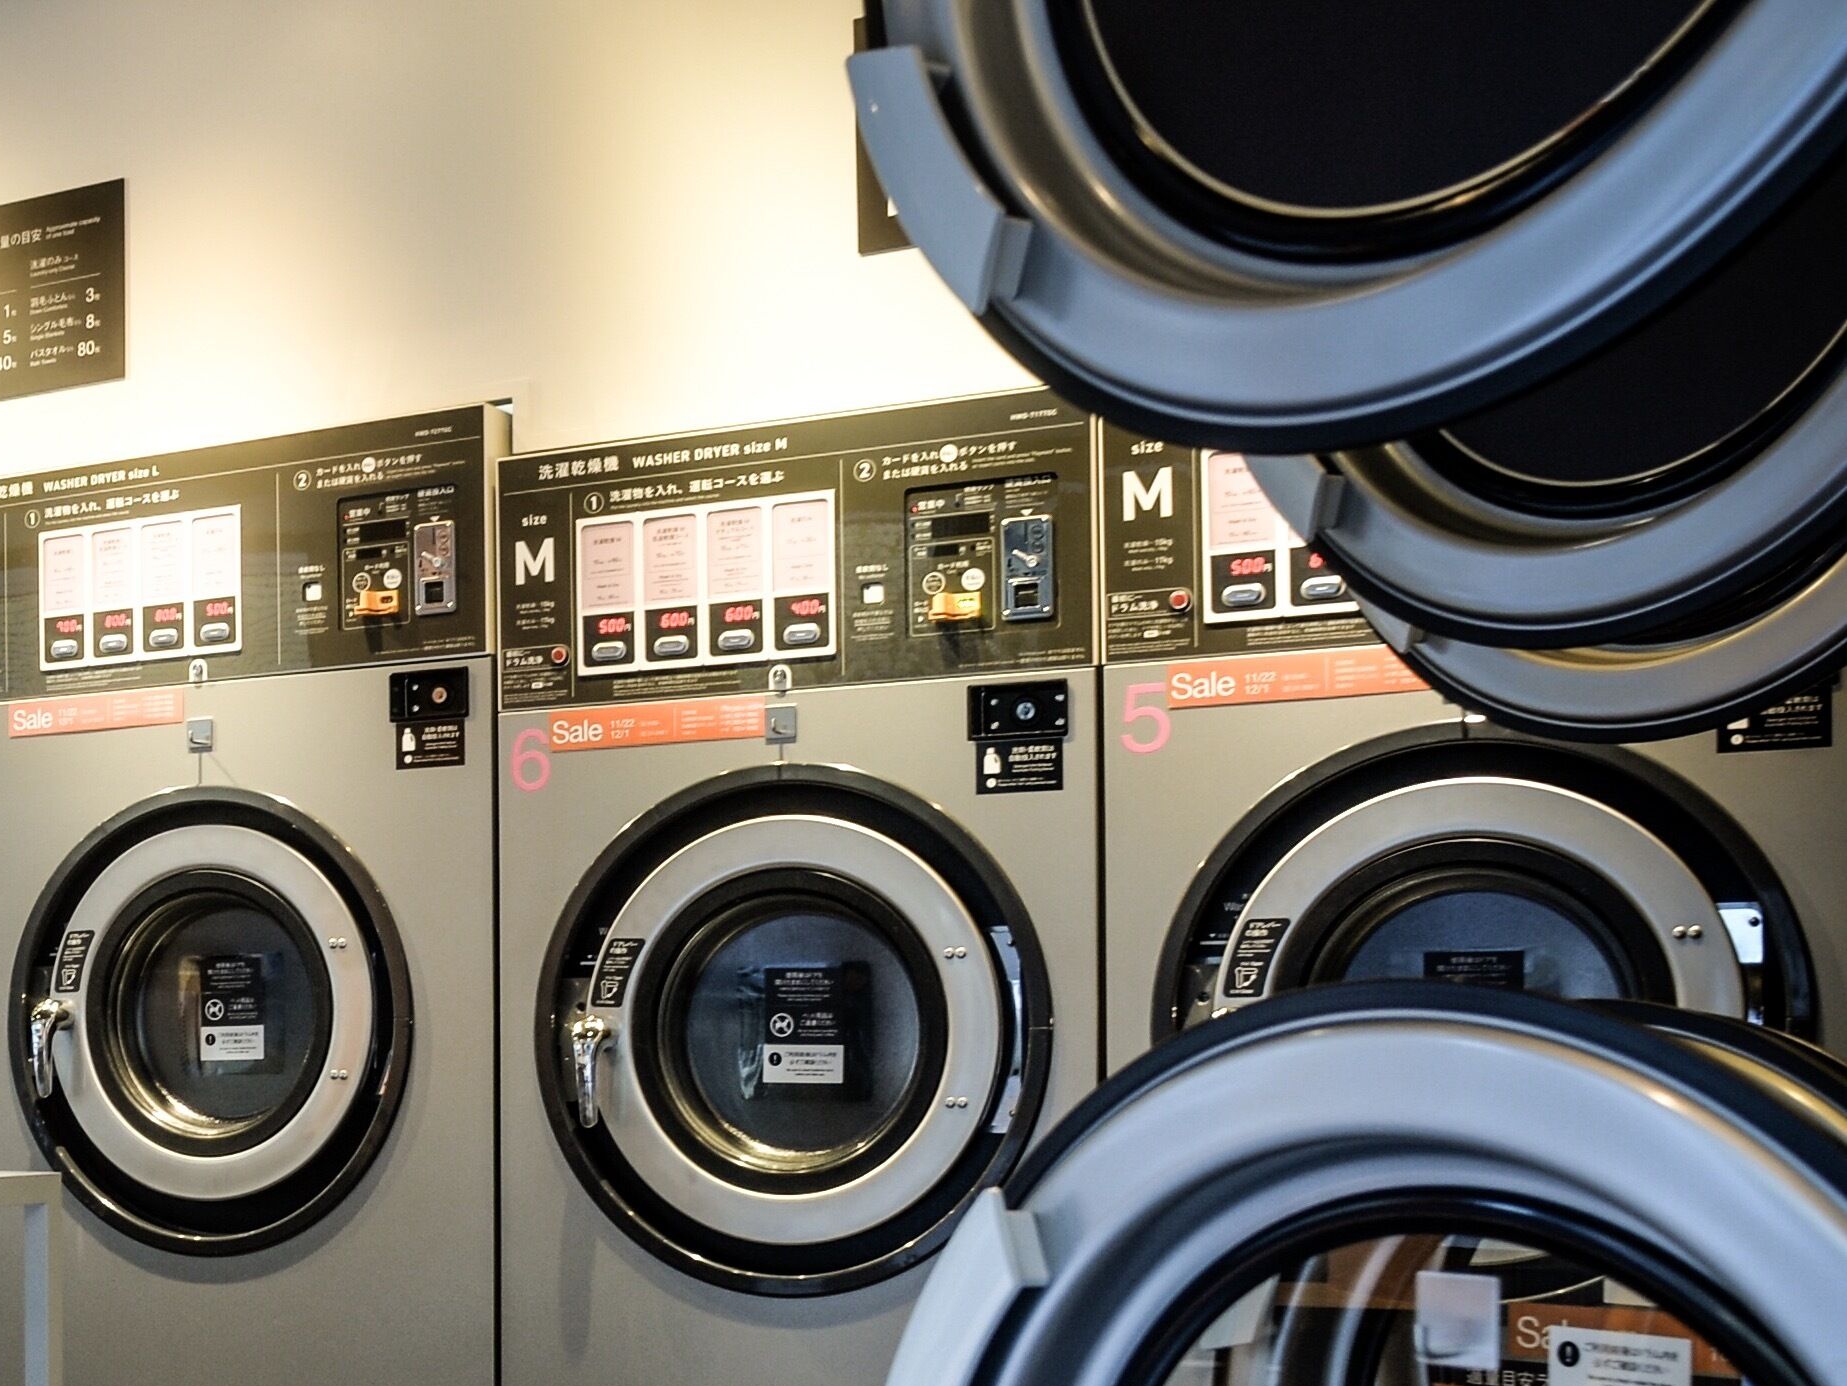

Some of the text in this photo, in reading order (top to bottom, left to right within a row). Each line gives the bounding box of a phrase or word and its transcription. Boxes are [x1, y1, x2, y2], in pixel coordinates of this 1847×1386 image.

[538, 437, 788, 481] 洗濯乾燥機 WASHER DRYER size M
[1130, 440, 1164, 455] size
[43, 476, 88, 493] WASHER
[90, 470, 127, 486] DRYER
[128, 467, 149, 481] size
[1122, 466, 1173, 522] M
[522, 514, 548, 527] size
[515, 537, 555, 586] M
[1170, 671, 1277, 701] Sale 11/22
[1245, 683, 1270, 694] 12/1
[13, 708, 53, 731] Sale
[553, 718, 635, 745] Sale 11/22
[1120, 682, 1171, 754] 5
[510, 728, 552, 792] 6
